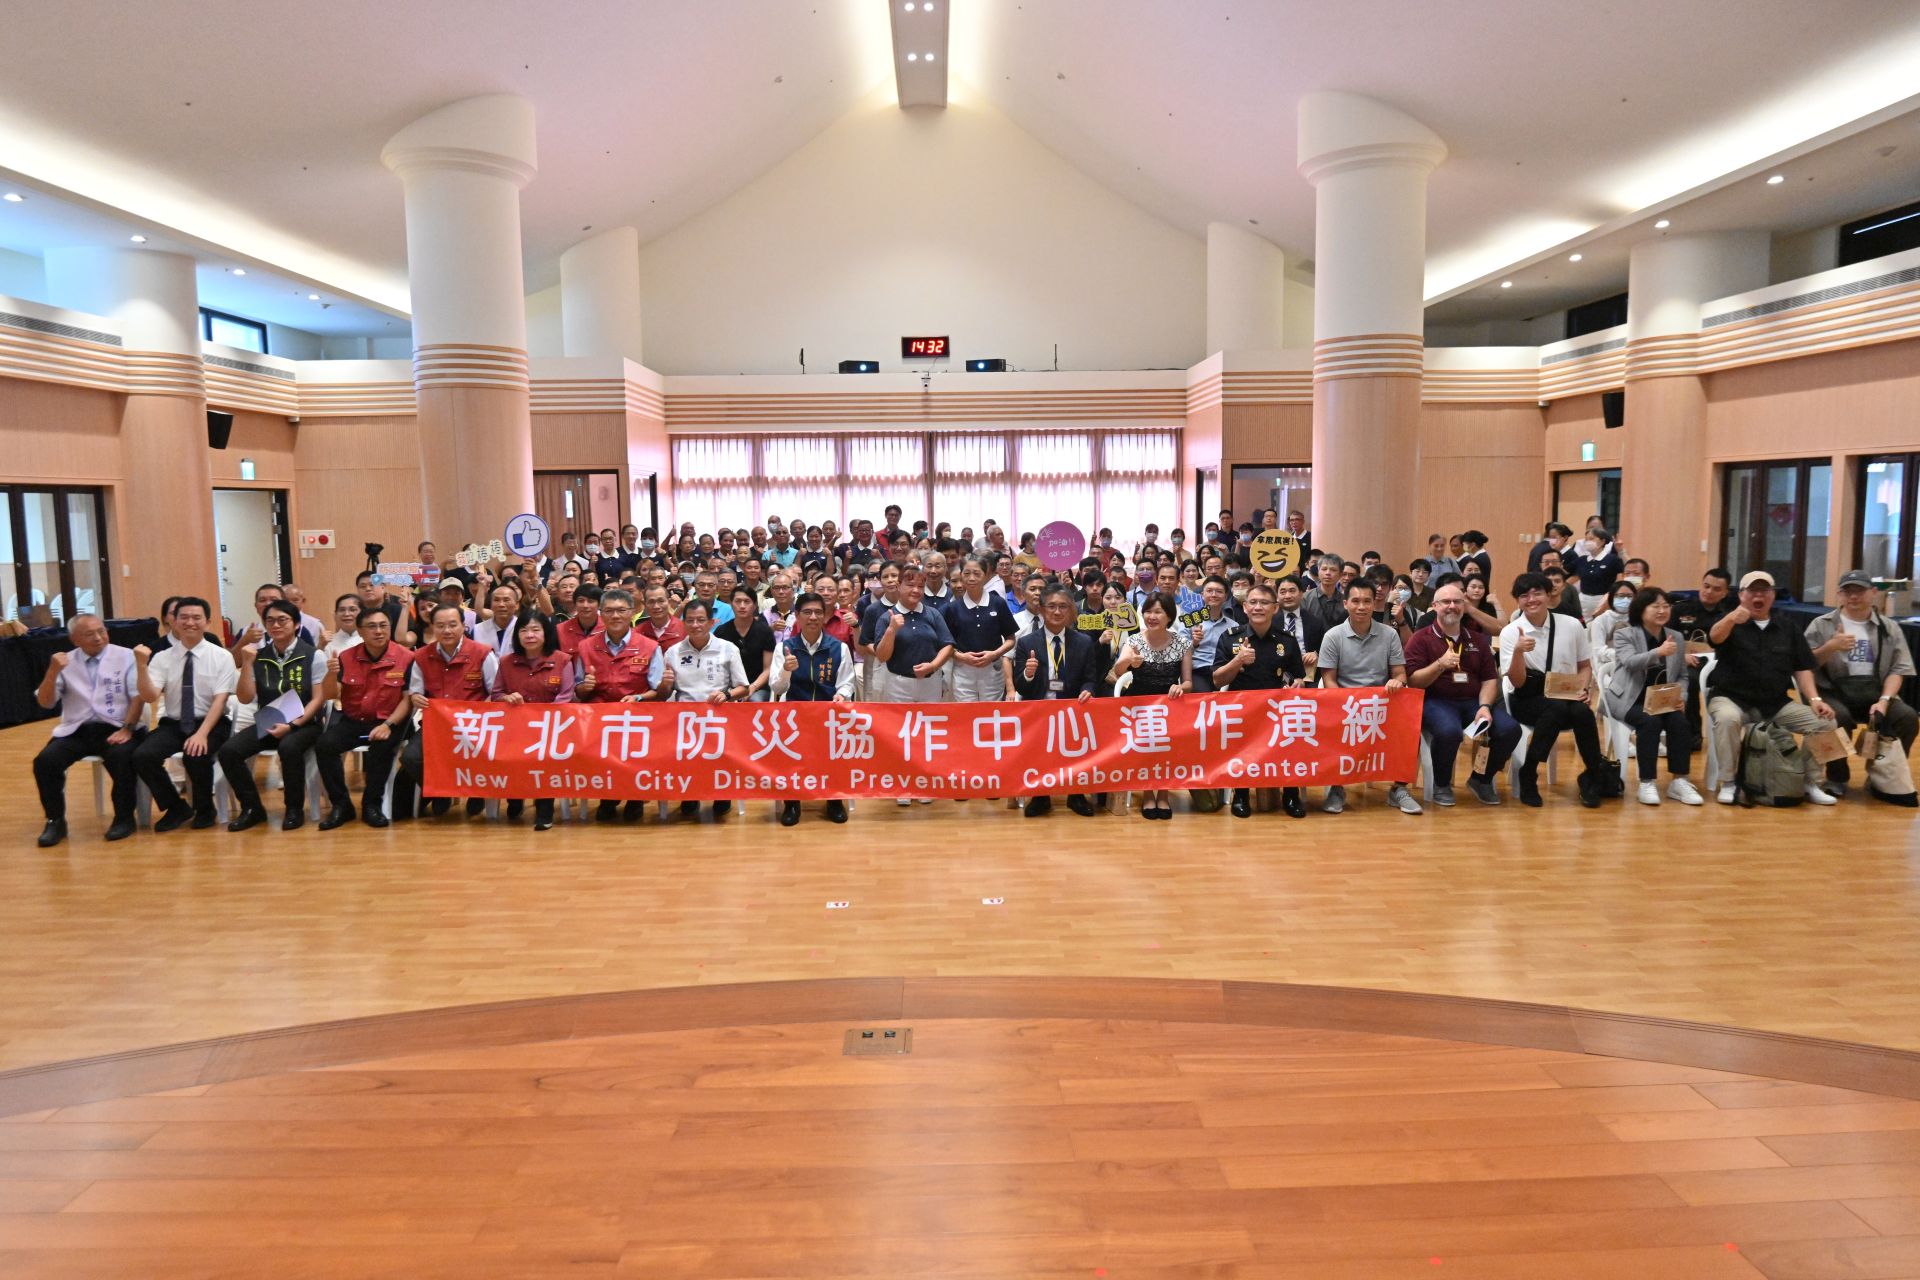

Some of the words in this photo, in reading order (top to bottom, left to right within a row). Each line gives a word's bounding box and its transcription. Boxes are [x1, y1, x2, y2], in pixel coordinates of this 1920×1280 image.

[452, 694, 1389, 762] 新北市防災協作中心運作演練
[456, 768, 508, 789] New
[528, 770, 613, 791] Taipei
[635, 770, 692, 793] City
[713, 769, 829, 790] Disaster
[850, 769, 1001, 790] Prevention
[1023, 761, 1204, 788] Collaboration
[1227, 758, 1319, 778] Center
[1339, 752, 1385, 775] Drill
